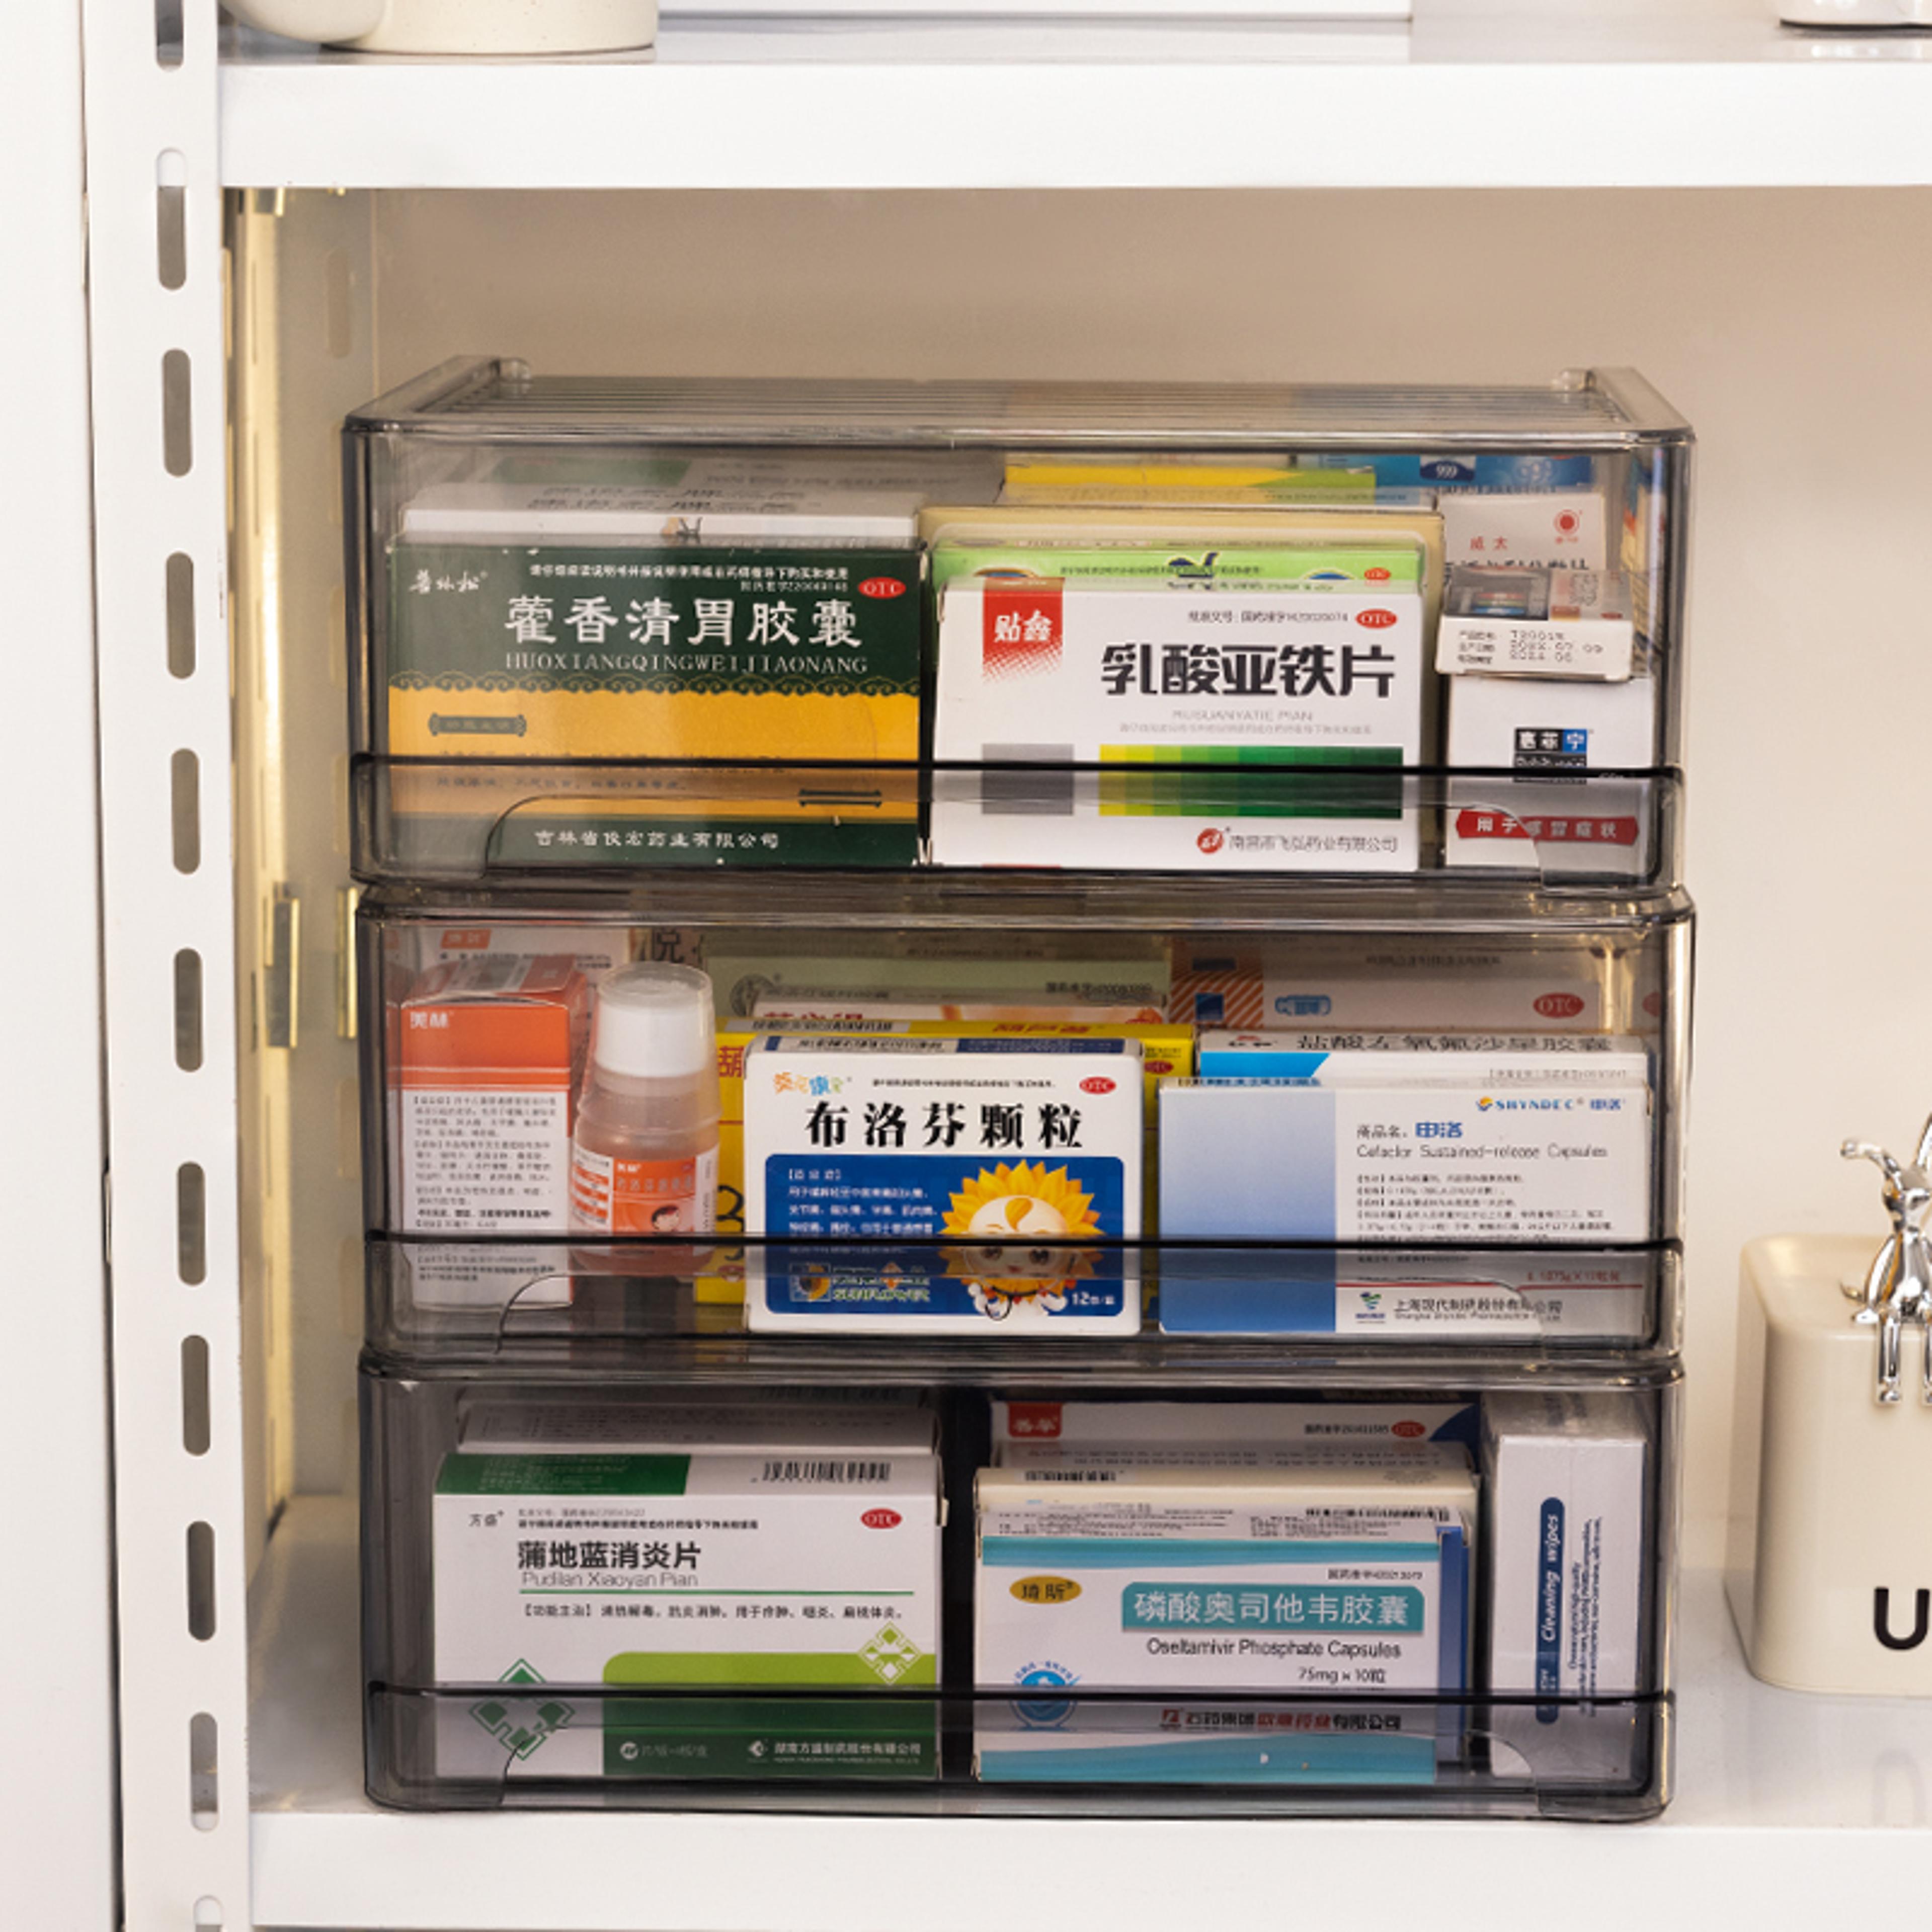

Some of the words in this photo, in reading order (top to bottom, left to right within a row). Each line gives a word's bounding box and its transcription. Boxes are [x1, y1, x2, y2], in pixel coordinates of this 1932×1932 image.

[862, 581, 903, 596] OTC
[505, 595, 862, 648] 藿香清胃胶囊
[1357, 611, 1395, 625] OTC
[506, 653, 867, 674] HUOXIANGQINGWEIJIAONANG
[1101, 643, 1395, 698] 乳酸亚铁片
[1538, 997, 1580, 1013] OTC
[805, 1101, 1083, 1149] 布洛芬颗粒
[864, 1511, 897, 1525] OTC
[1545, 1513, 1560, 1563] wipes
[517, 1540, 701, 1570] 蒲地蓝消炎片
[522, 1571, 583, 1588] Pudilan
[588, 1571, 657, 1589] Xiaoyan
[660, 1572, 699, 1587] Pian
[1135, 1591, 1409, 1625] 磷酸奥司他韦胶囊
[1541, 1571, 1560, 1643] Cleaning
[1873, 1586, 1930, 1651] U
[1147, 1638, 1235, 1656] Oseltamivir
[1239, 1639, 1324, 1659] Phosphate
[1327, 1640, 1402, 1660] Capsules
[1298, 1667, 1339, 1684] 75mg
